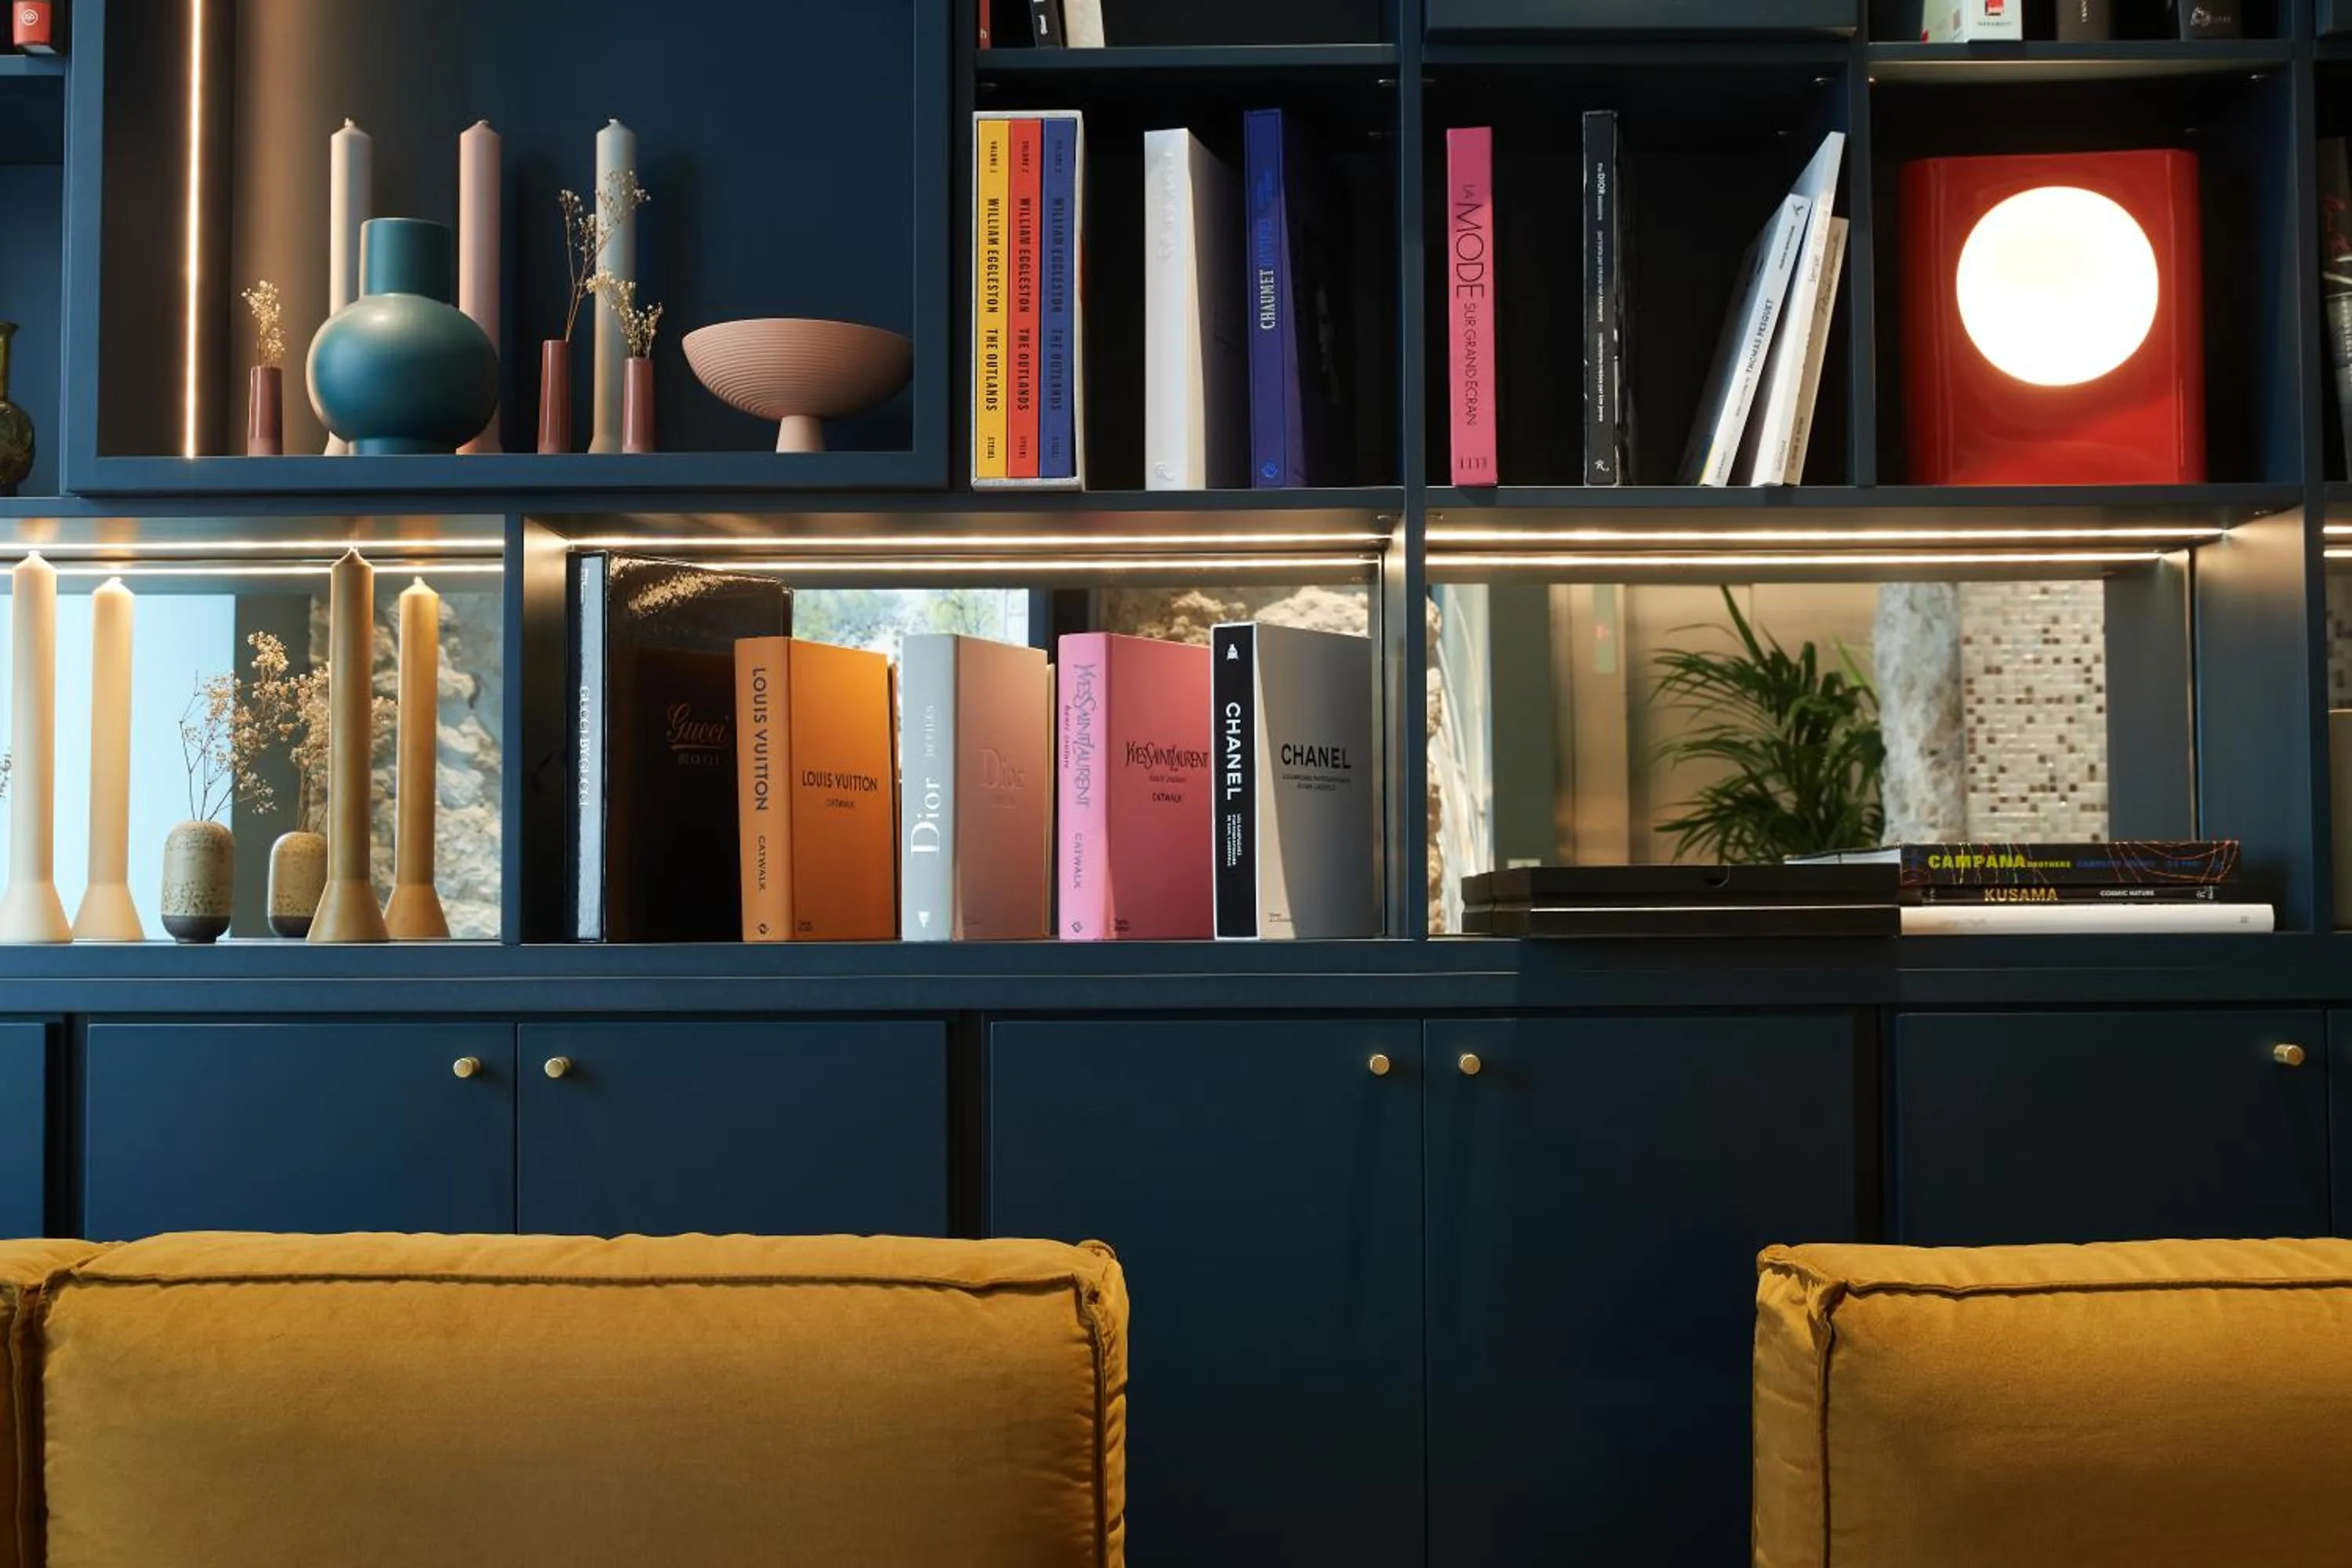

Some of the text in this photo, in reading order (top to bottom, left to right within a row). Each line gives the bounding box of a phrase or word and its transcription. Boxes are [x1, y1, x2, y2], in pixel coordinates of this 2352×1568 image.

[1598, 172, 1606, 195] DIOR
[986, 198, 1000, 313] WILLIAM EGGLESTON
[1018, 198, 1031, 313] WILLIAM EGGLESTON
[1051, 198, 1065, 313] WILLIAM EGGLESTON
[1455, 202, 1485, 299] MODE
[1259, 269, 1276, 330] CHAUMET
[1463, 303, 1476, 326] SUR
[1464, 328, 1477, 378] GRAND
[1745, 298, 1774, 373] THOMAS PESQUET
[985, 328, 998, 412] THE OUTLANDS
[1017, 328, 1029, 412] THE OUTLANDS
[1050, 328, 1063, 411] THE OUTLANDS
[579, 738, 590, 757] BY
[666, 702, 730, 743] Gucci
[751, 667, 769, 811] LOUIS VUITTON
[1225, 702, 1242, 800] CHANEL
[801, 770, 878, 792] LOUIS VUITTON
[976, 746, 1028, 790] Dior
[1280, 742, 1352, 769] CHANEL
[909, 777, 941, 858] Dior
[757, 835, 767, 891] CATWALK
[1073, 832, 1083, 889] CATWALK
[1927, 853, 2027, 869] CAMPANA
[1984, 887, 2058, 902] KUSAMA
